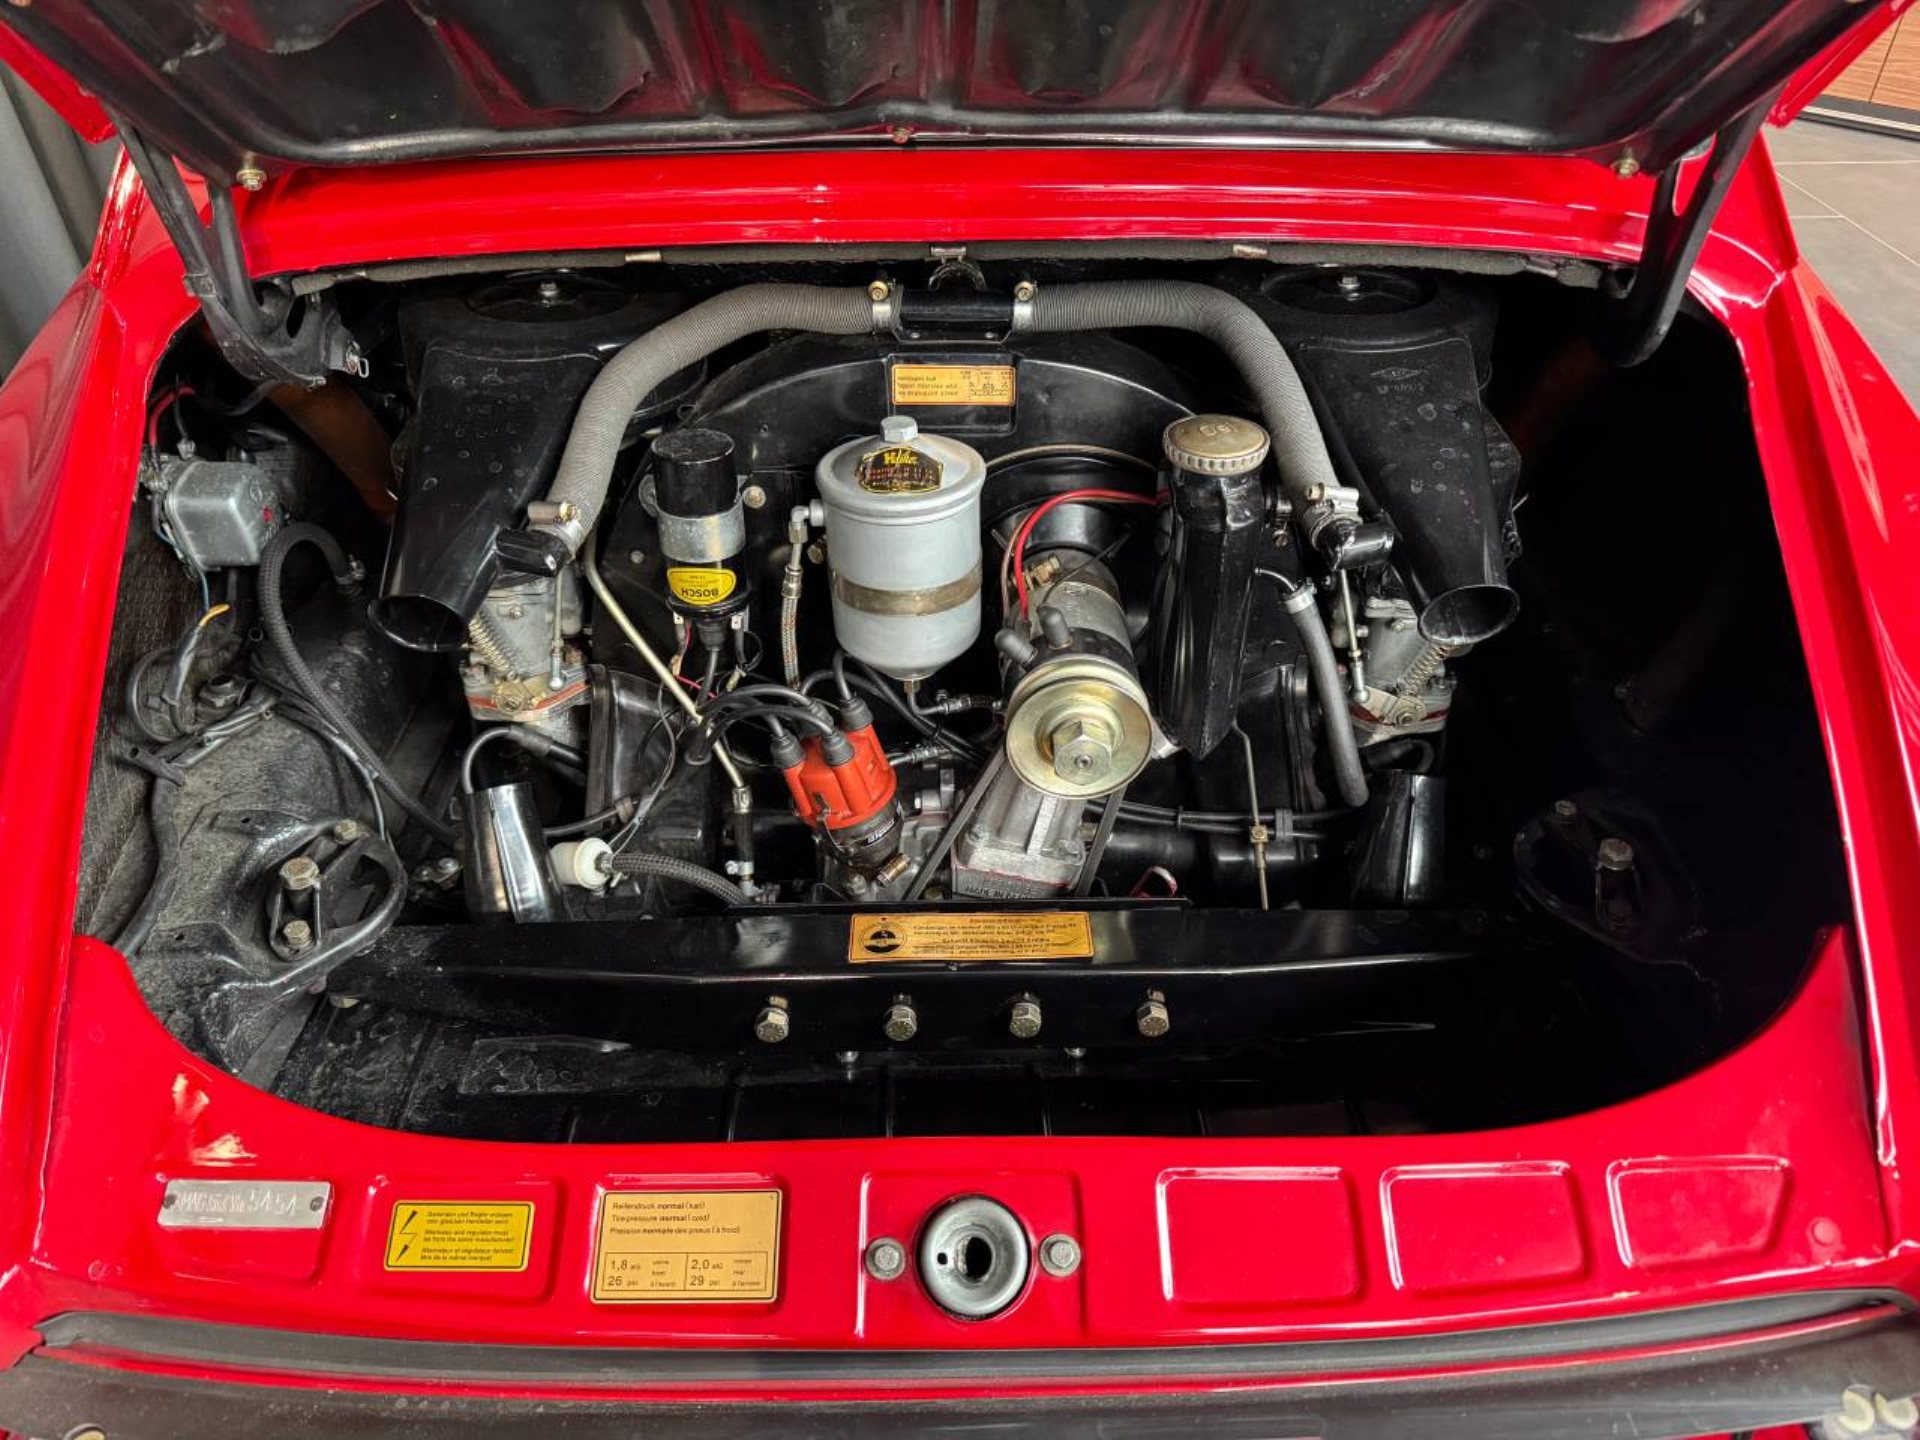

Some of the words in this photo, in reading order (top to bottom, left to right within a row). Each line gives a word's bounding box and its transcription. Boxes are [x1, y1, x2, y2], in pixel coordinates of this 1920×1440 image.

[681, 588, 719, 598] BOSCH
[659, 1214, 687, 1222] normal
[610, 1260, 628, 1271] 1,8
[691, 1260, 710, 1271] 2,0
[608, 1276, 622, 1286] 26
[689, 1275, 704, 1286] 29
